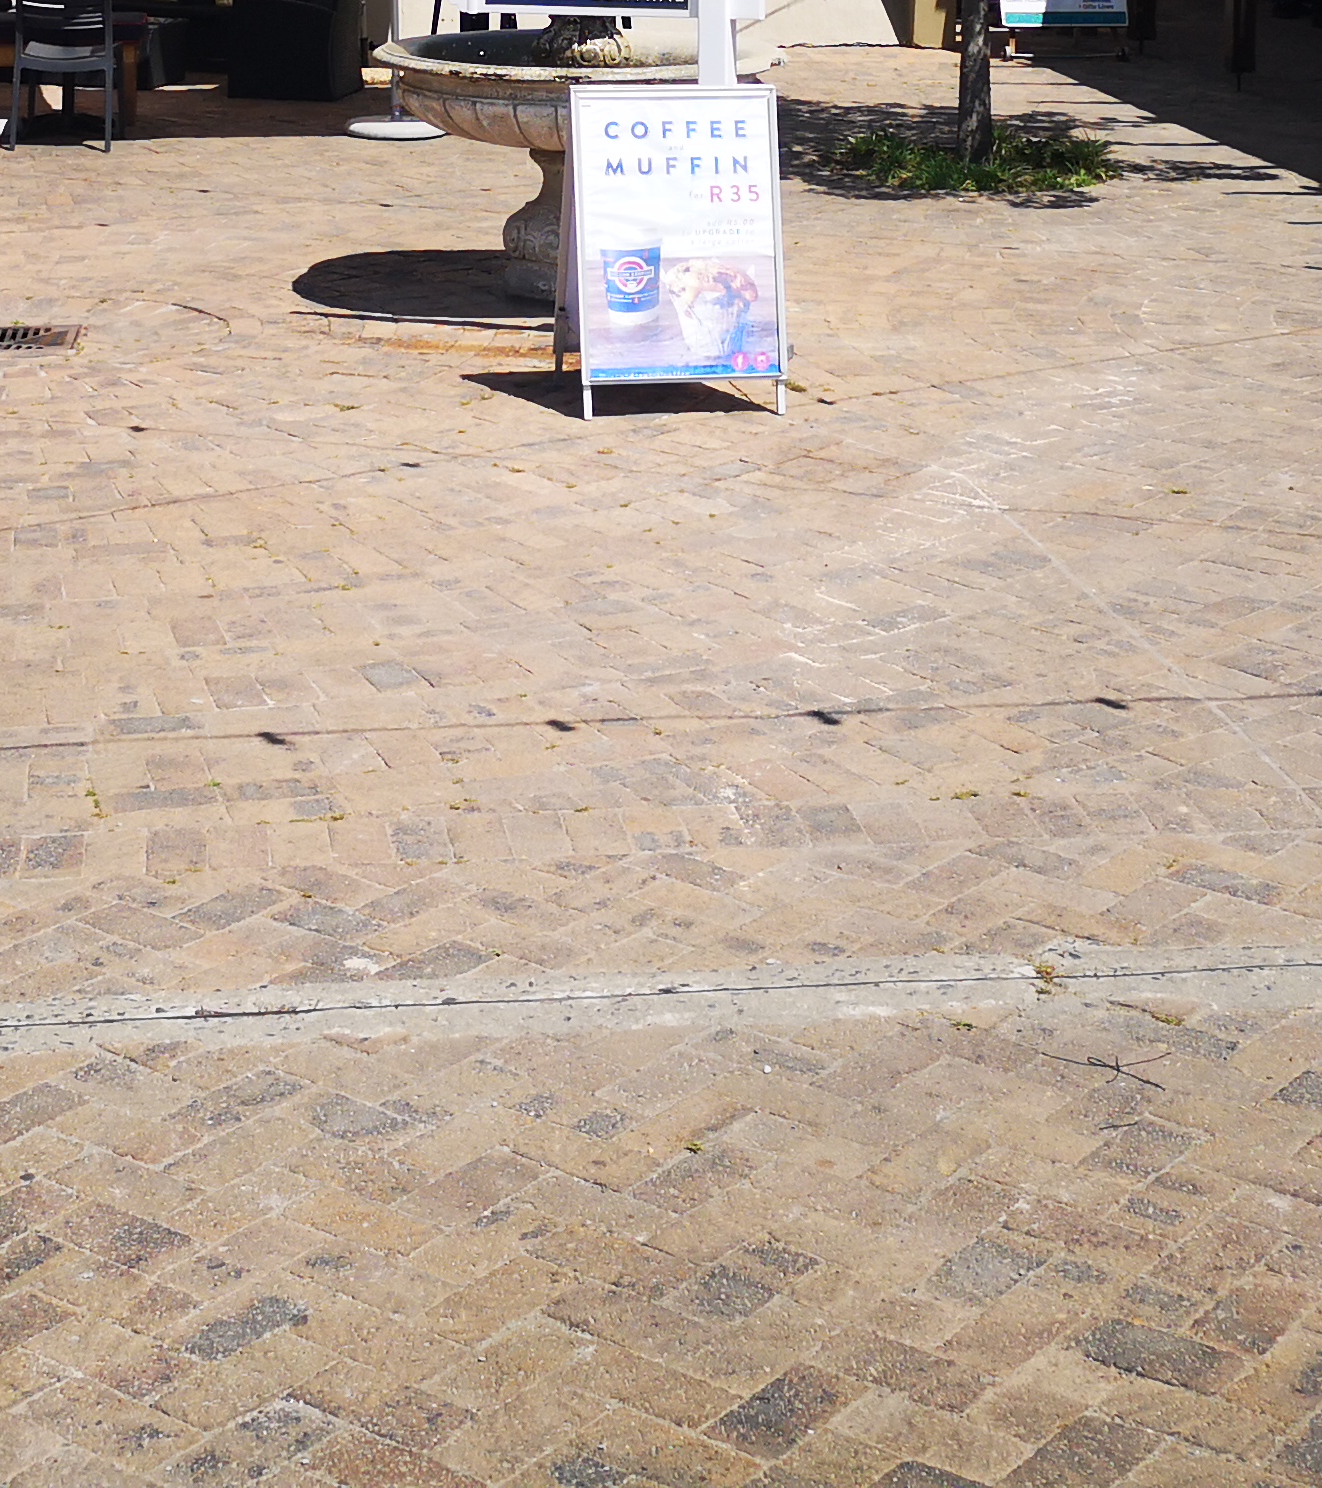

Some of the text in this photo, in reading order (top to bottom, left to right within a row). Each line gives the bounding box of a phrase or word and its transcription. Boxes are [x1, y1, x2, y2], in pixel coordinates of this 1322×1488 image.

[604, 120, 748, 140] COFFEE
[604, 155, 749, 176] MUFFIN
[709, 184, 761, 203] R35
